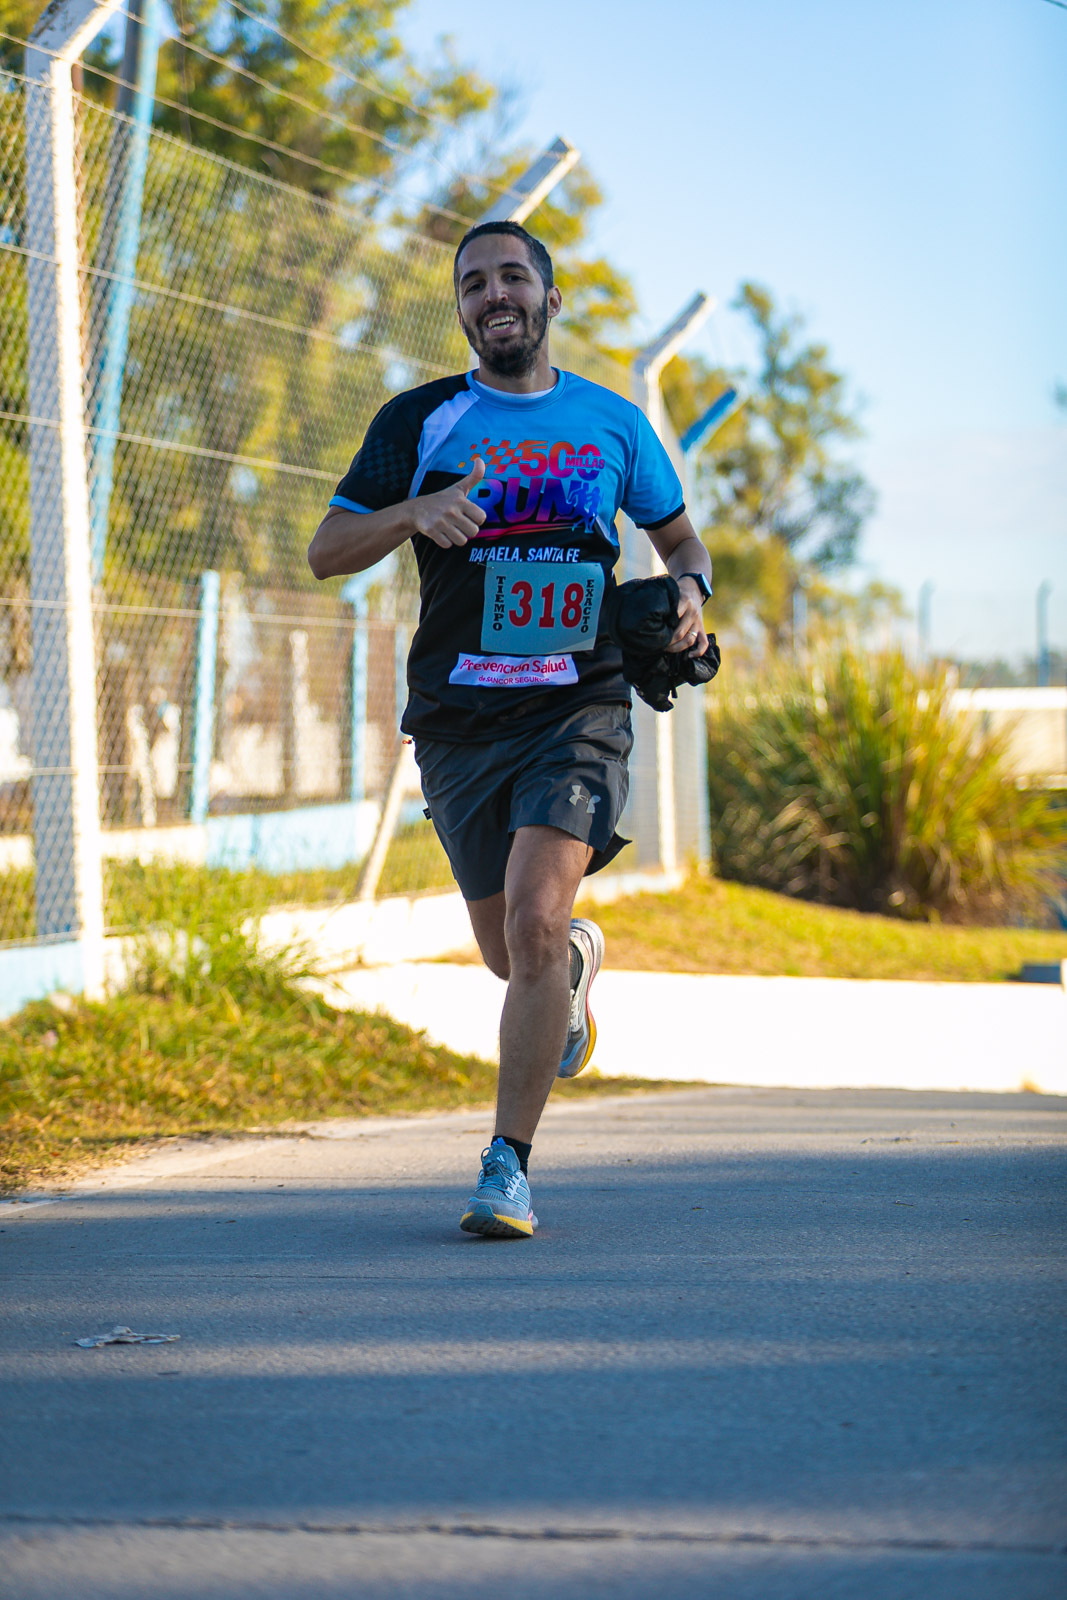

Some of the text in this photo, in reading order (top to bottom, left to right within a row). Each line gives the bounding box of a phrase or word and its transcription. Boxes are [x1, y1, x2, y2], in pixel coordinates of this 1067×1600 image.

[565, 457, 605, 469] MILLAS
[467, 478, 582, 524] RUN
[527, 546, 564, 562] SANTA
[566, 548, 580, 563] FE
[492, 576, 506, 631] TIEMPO
[508, 581, 584, 628] 318
[580, 579, 595, 633] EXACTO
[531, 658, 568, 674] Salud
